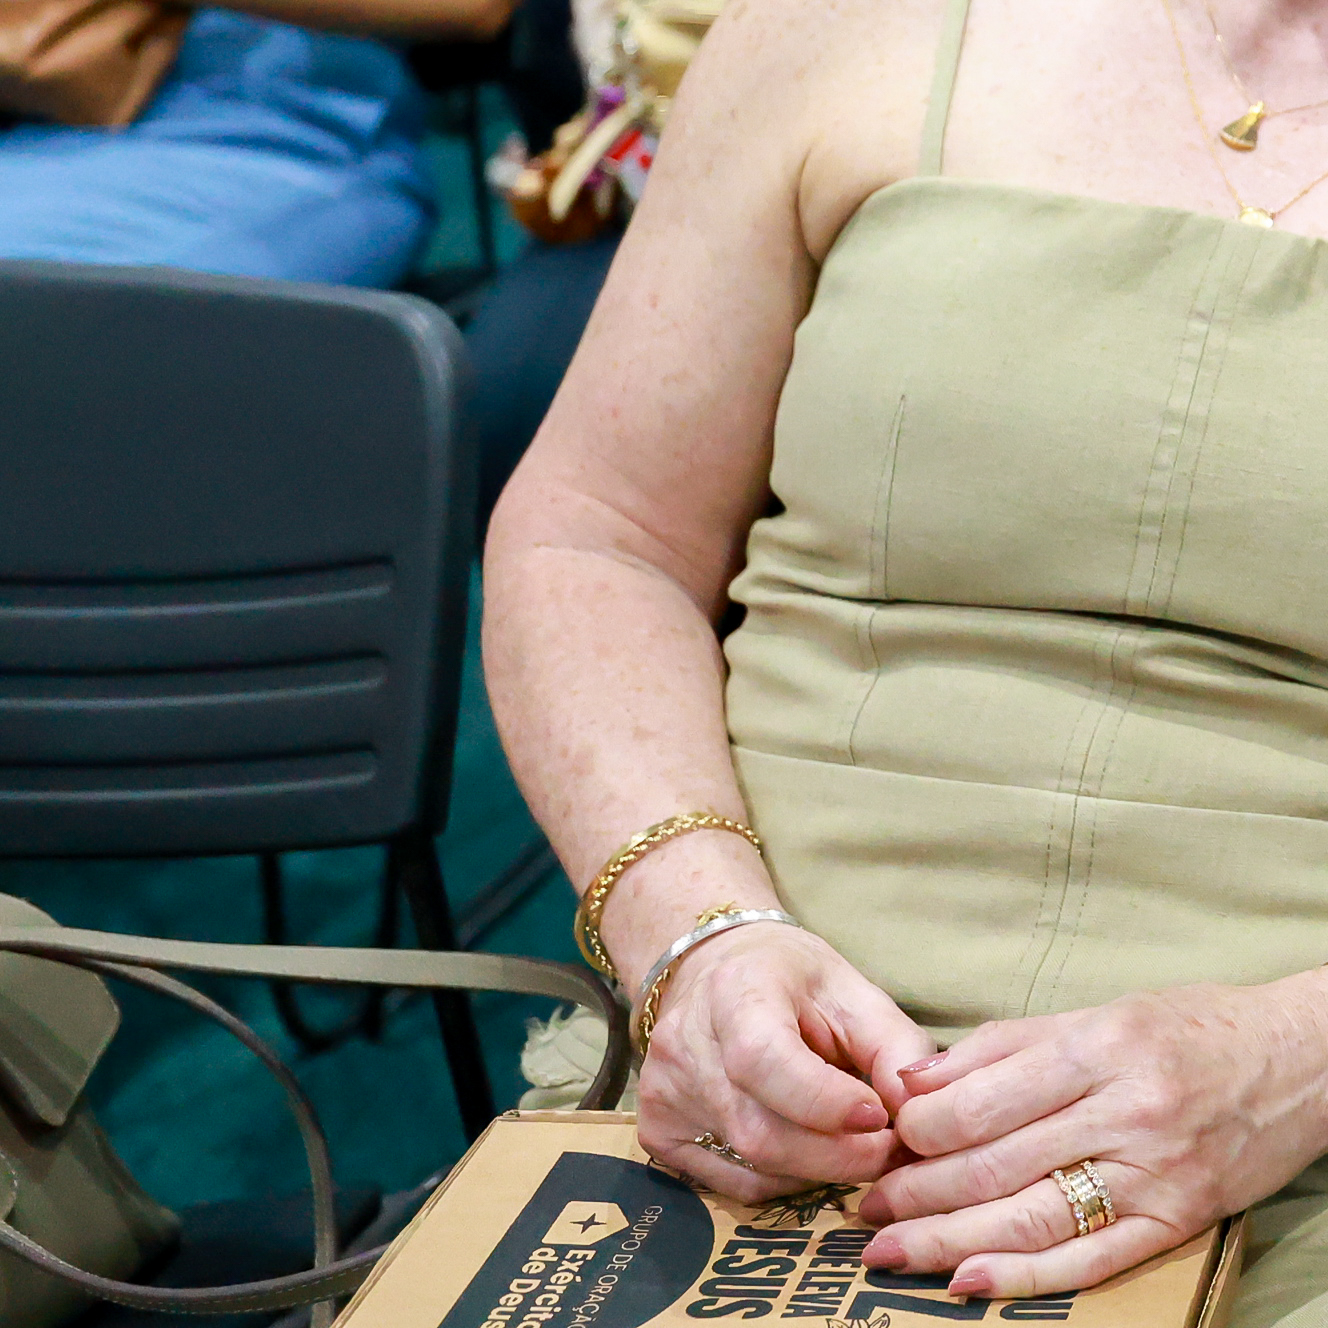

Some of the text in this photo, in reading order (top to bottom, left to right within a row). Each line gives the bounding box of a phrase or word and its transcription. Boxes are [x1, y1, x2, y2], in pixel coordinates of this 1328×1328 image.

[621, 1205, 663, 1252] GRUPO
[521, 1247, 559, 1274] de
[605, 1253, 633, 1272] DE
[685, 1224, 815, 1320] JESUS
[780, 1229, 878, 1319] QUE LEVA
